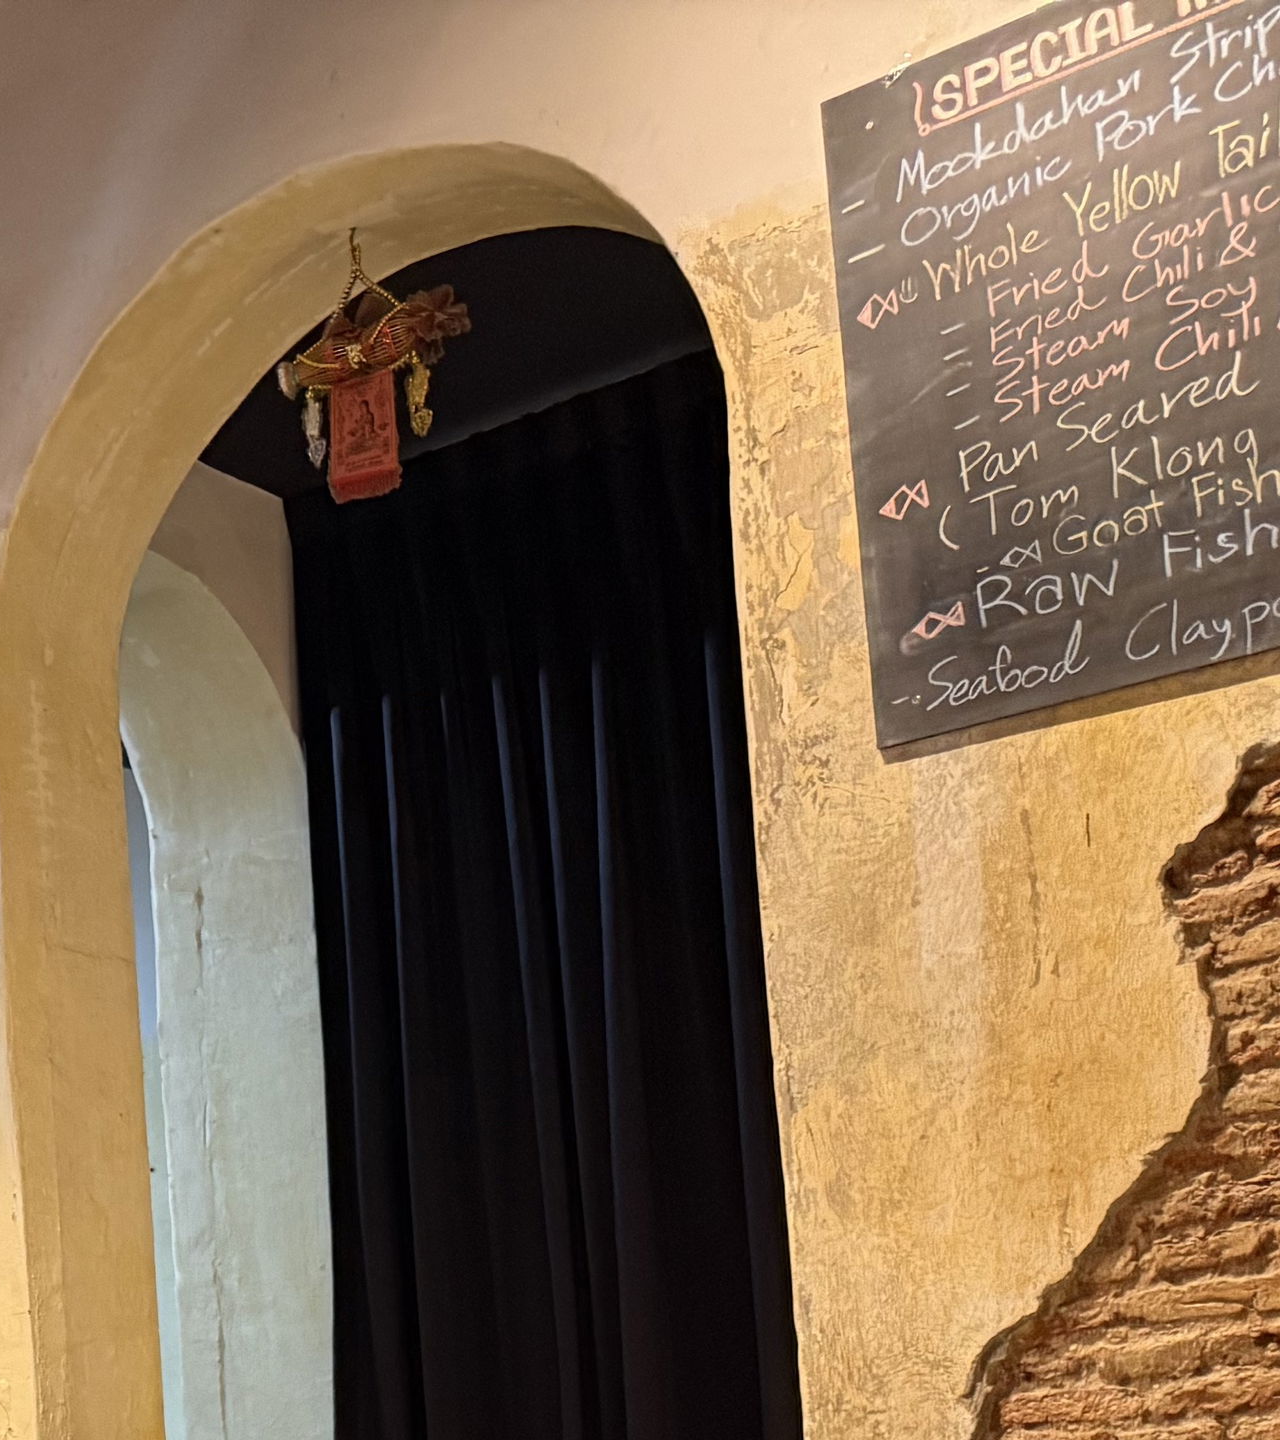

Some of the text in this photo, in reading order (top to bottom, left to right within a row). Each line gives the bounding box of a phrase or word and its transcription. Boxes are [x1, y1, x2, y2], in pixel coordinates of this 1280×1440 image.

[931, 1, 1154, 120] SPECIAL
[900, 54, 1280, 246] Organic Pork Ch
[922, 112, 1280, 300] Whole Yellow Tai
[987, 185, 1280, 317] Fried Garlic
[991, 221, 1256, 352] Fried Chili &
[992, 276, 1256, 385] Steam Soy
[994, 301, 1261, 422] Steam Chili
[958, 350, 1261, 492] Pan Seared
[1110, 428, 1259, 498] Klong
[1052, 457, 1280, 555] Goat Fish
[1162, 508, 1280, 578] Fish
